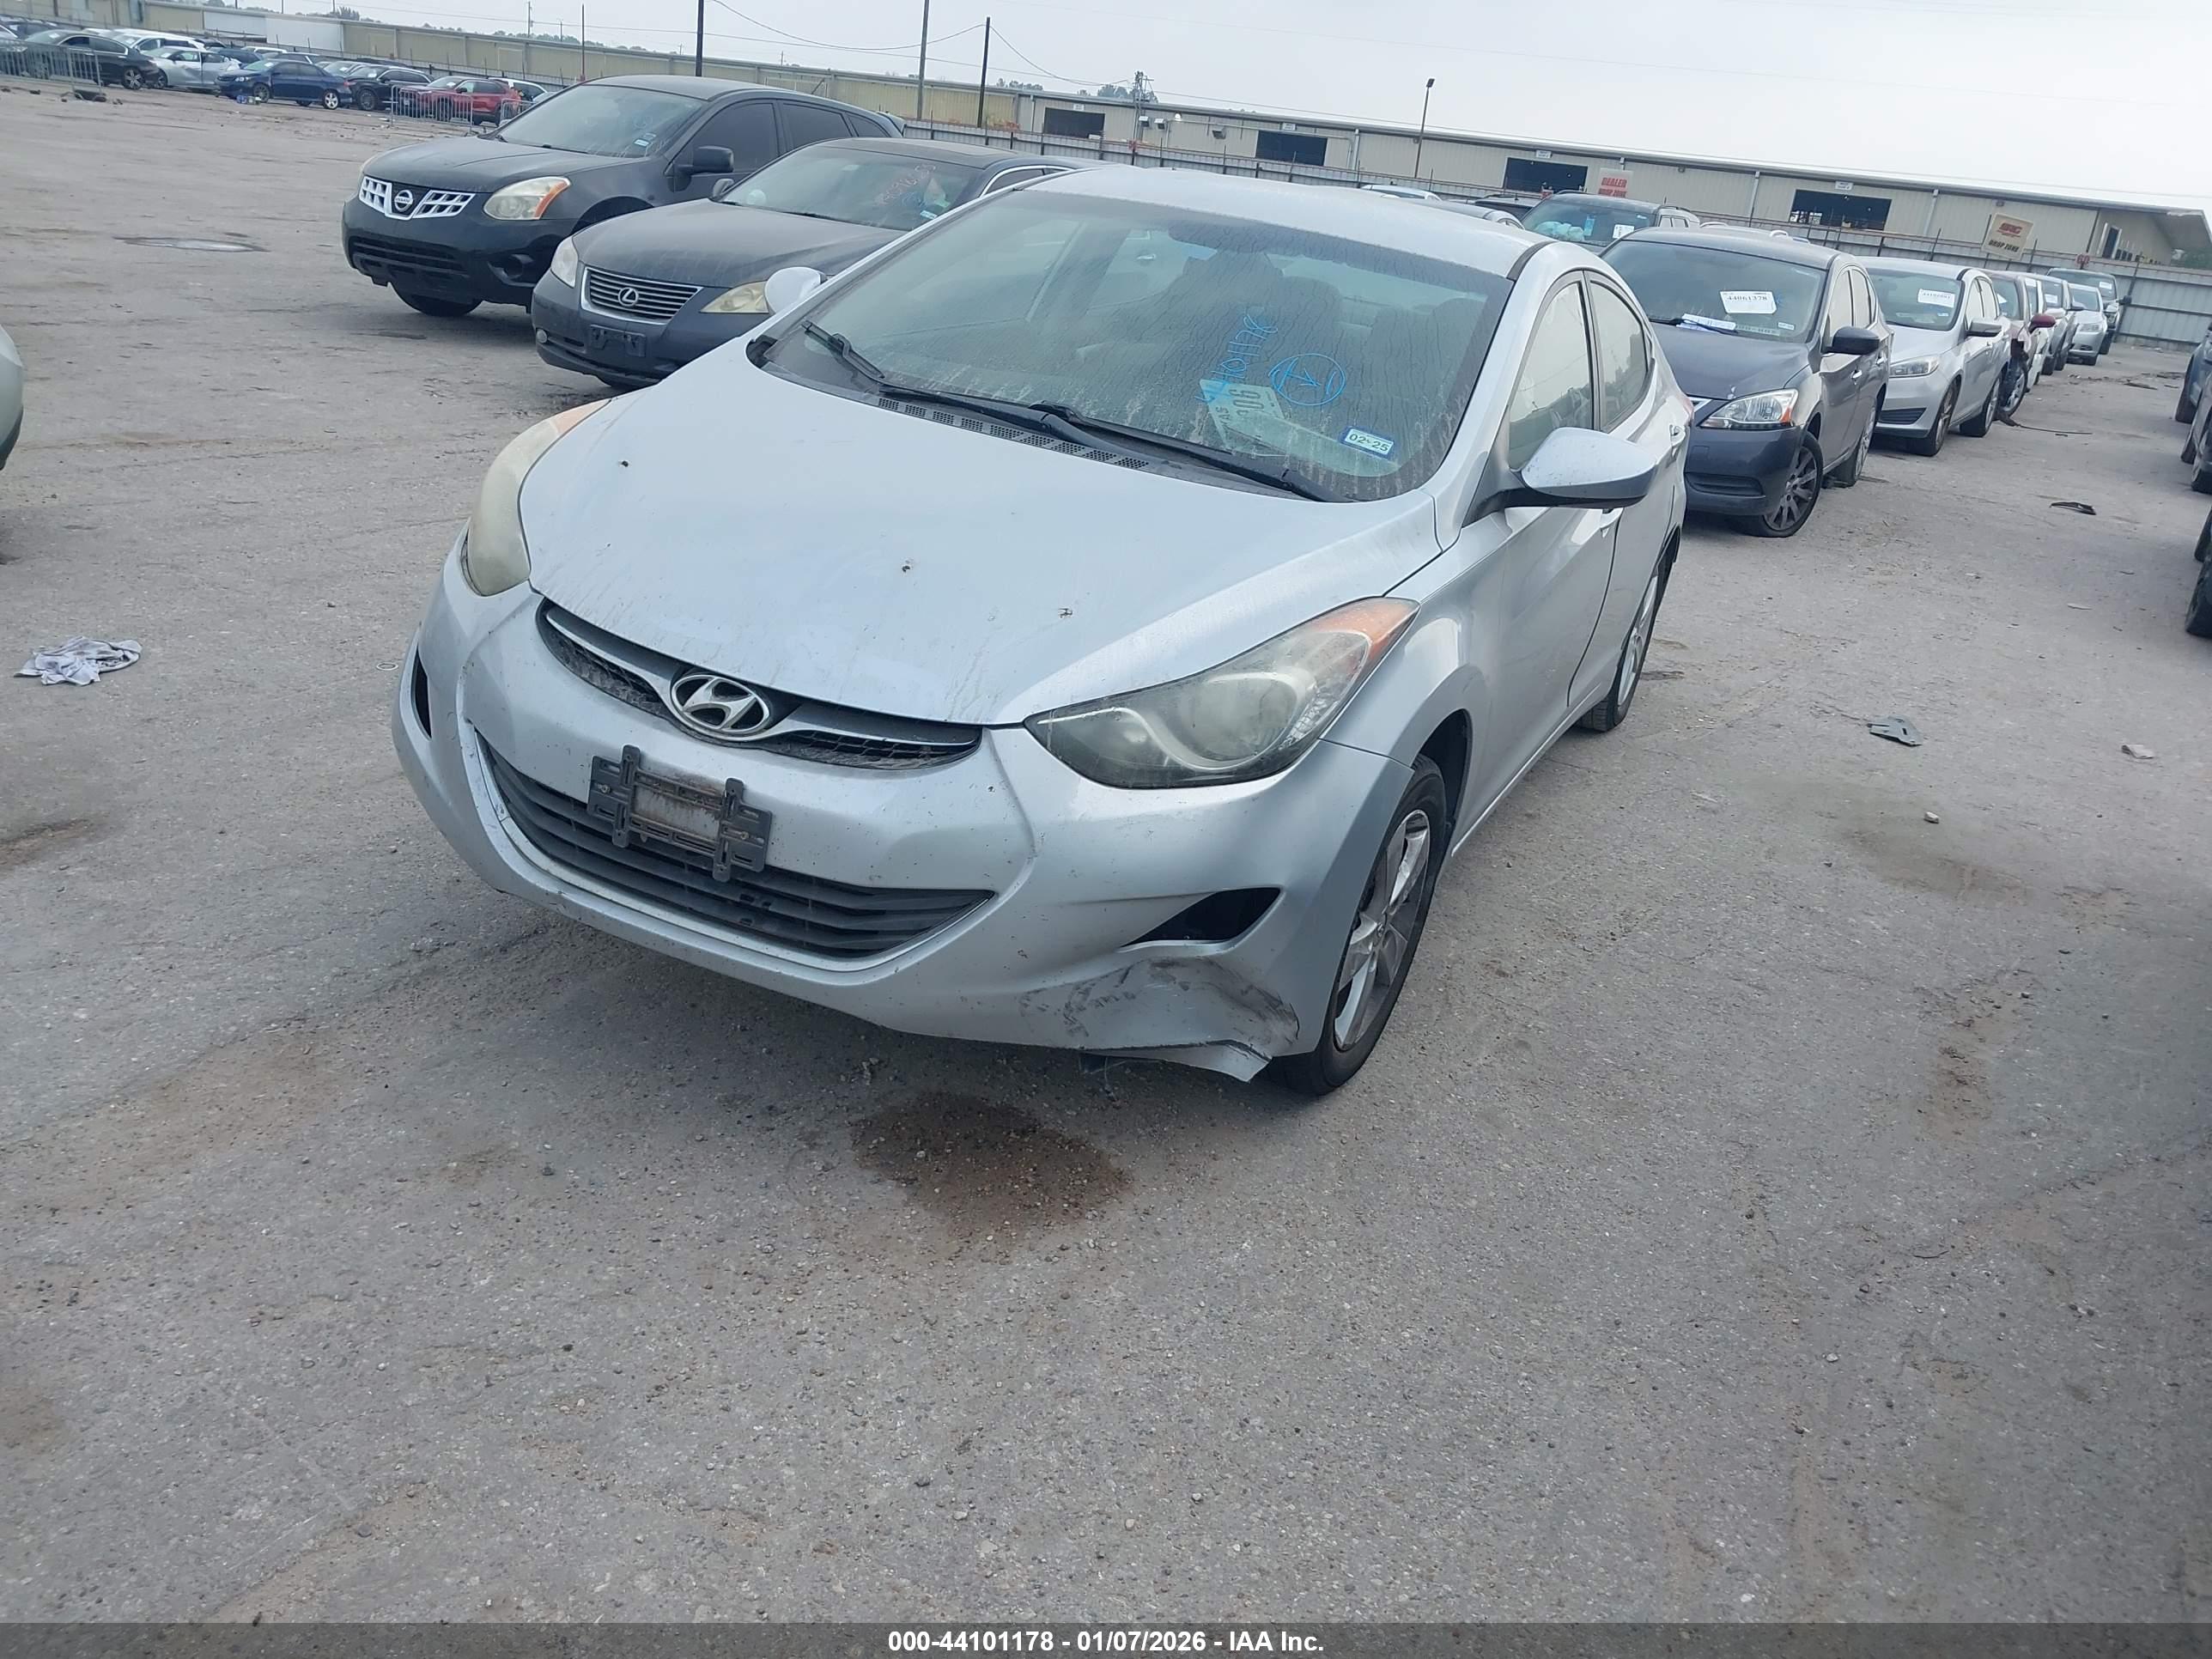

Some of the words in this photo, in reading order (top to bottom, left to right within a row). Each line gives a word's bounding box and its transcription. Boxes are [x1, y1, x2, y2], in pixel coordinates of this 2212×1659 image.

[1601, 177, 1627, 187] DEALER
[1988, 239, 2005, 248] DROP
[2004, 243, 2020, 252] ZONE
